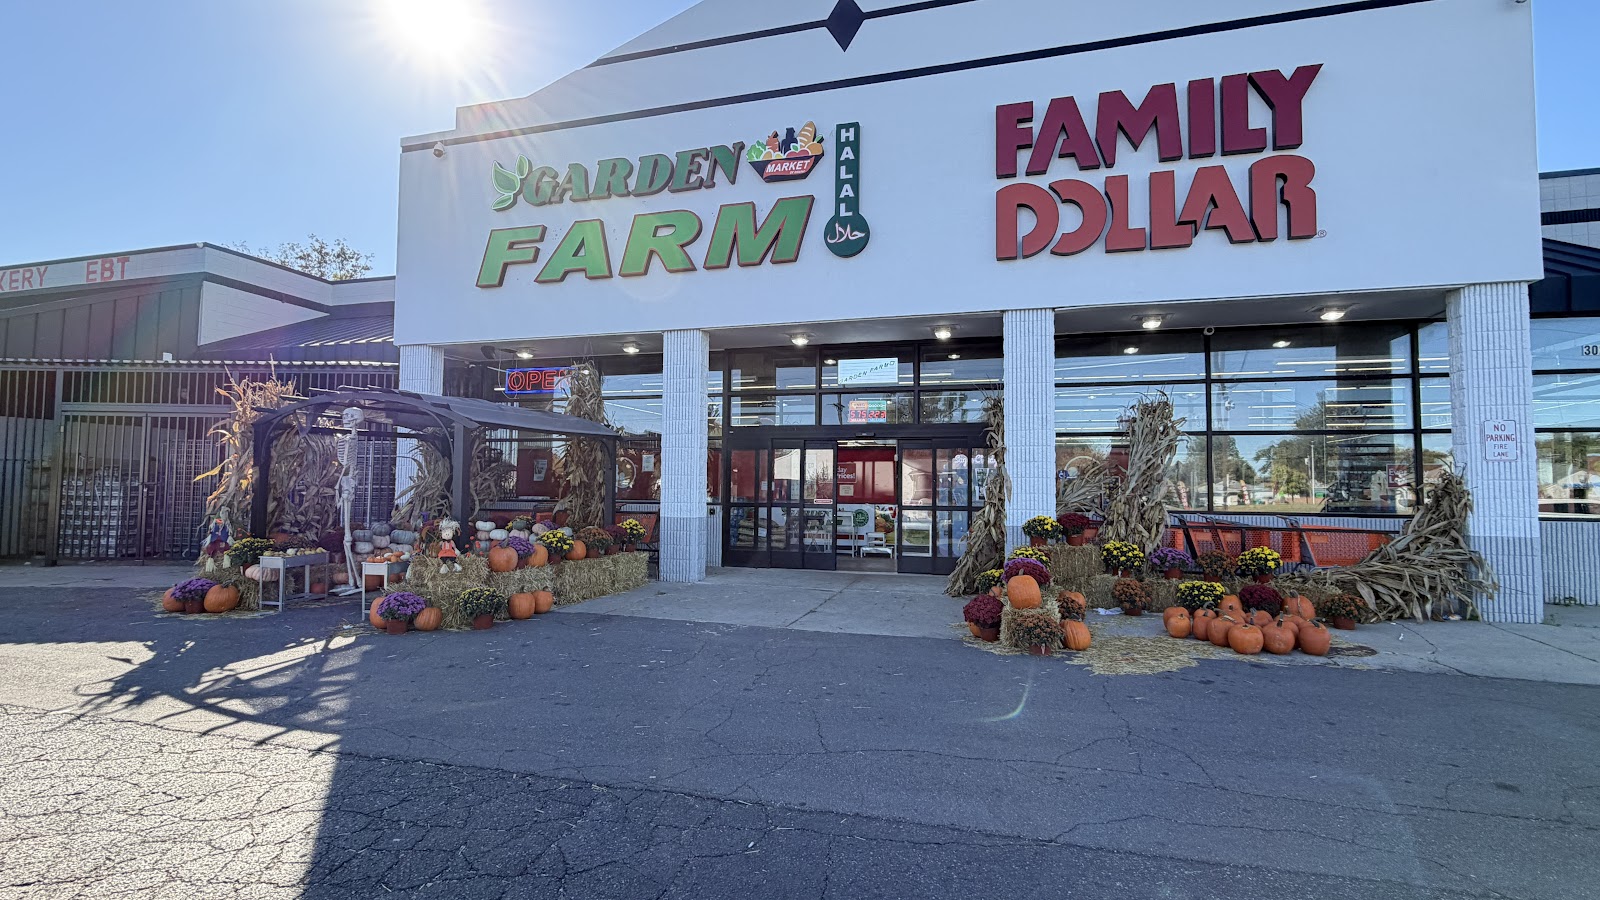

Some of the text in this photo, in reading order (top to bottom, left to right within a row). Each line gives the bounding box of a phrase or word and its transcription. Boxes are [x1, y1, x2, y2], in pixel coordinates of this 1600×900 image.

[996, 63, 1324, 179] FAMILY
[521, 141, 745, 207] GARDEN
[765, 160, 811, 173] MARKET
[839, 127, 855, 217] HALAL
[996, 154, 1317, 262] DOLLAR
[475, 194, 815, 288] FARM
[827, 220, 866, 244] حلال
[86, 257, 130, 283] EBT
[1584, 345, 1600, 356] 30
[1486, 433, 1516, 442] PARKING
[1493, 424, 1506, 432] NO
[837, 472, 856, 480] rices!
